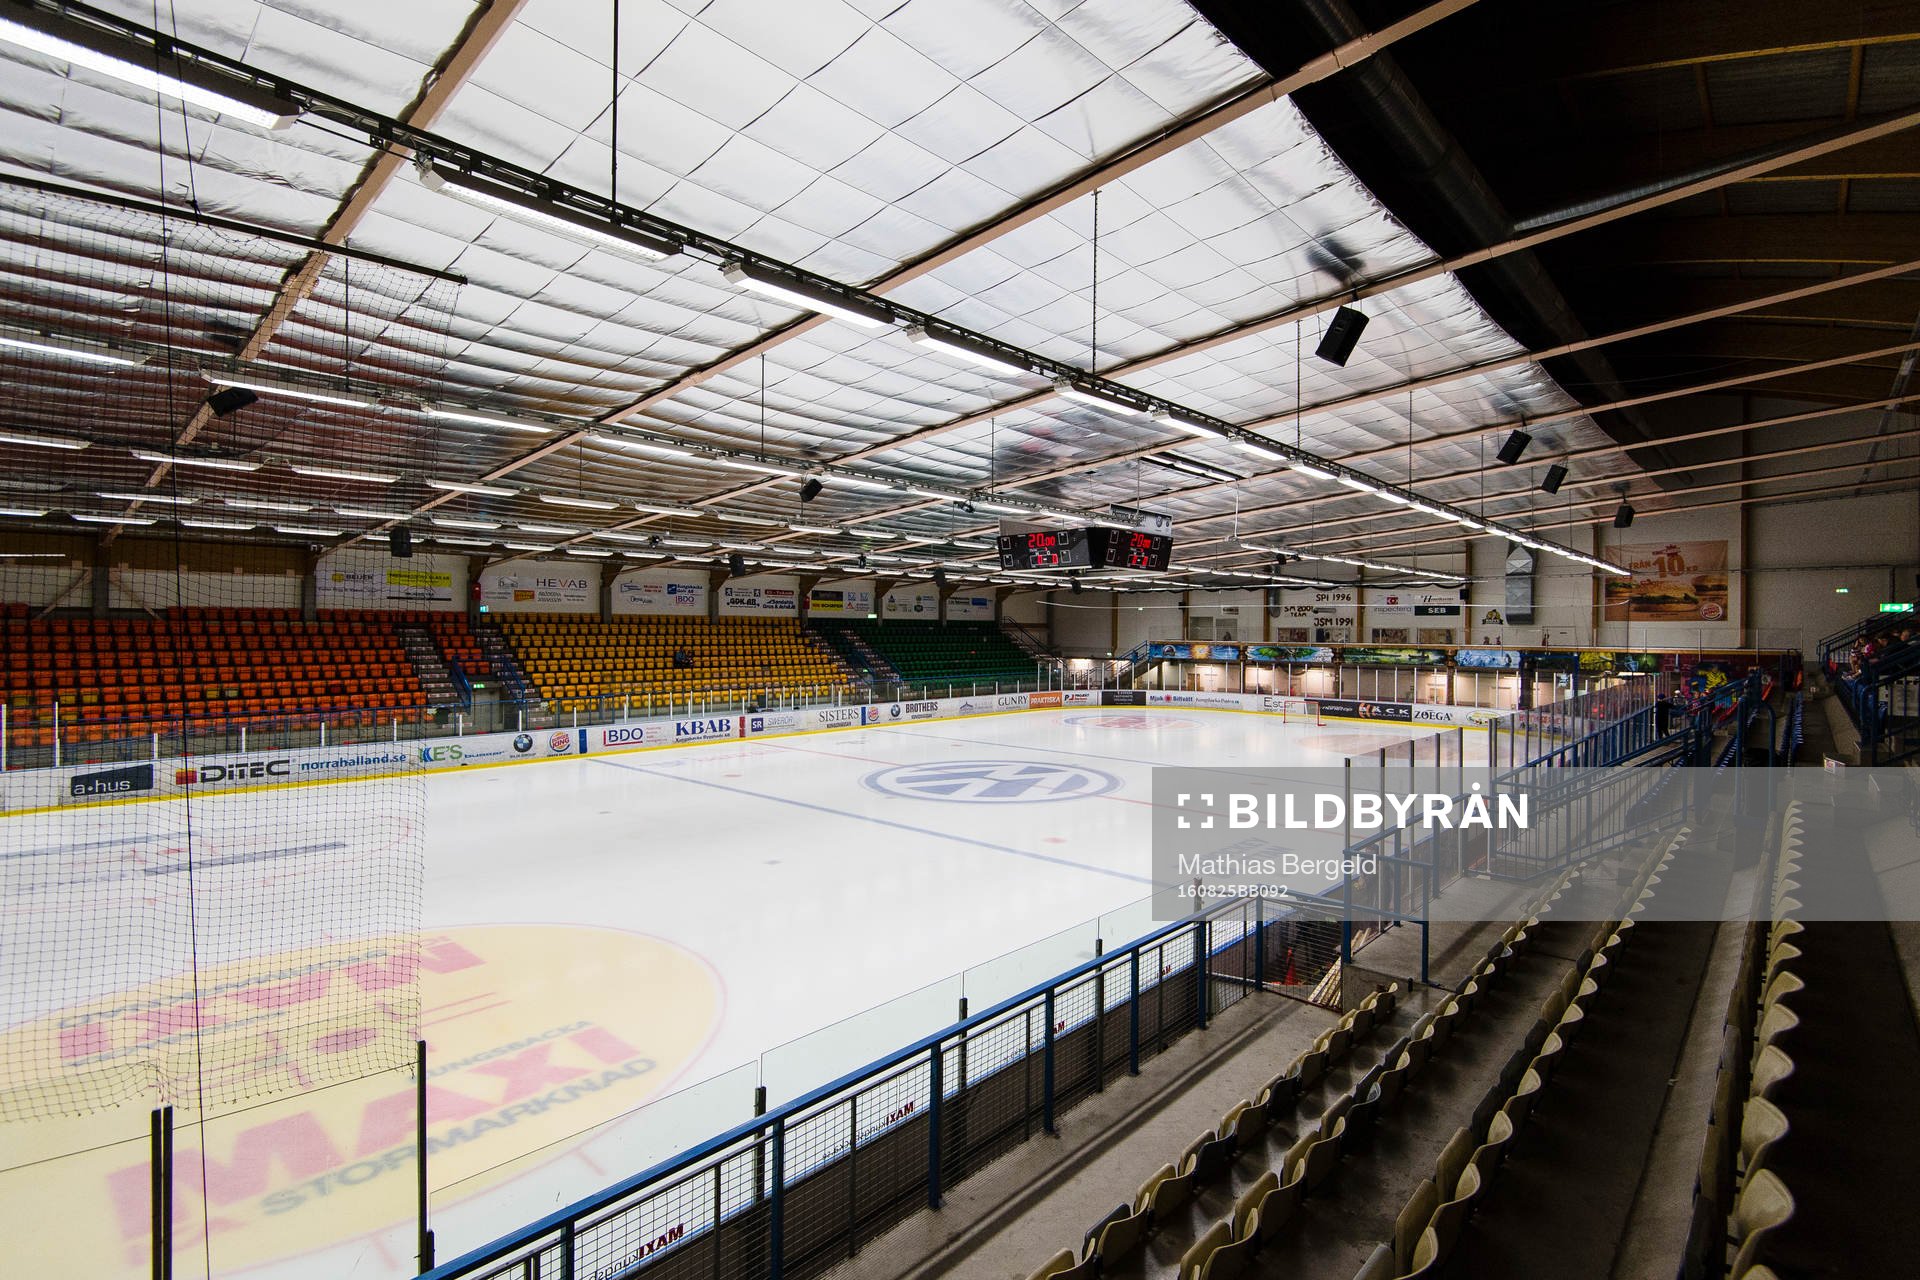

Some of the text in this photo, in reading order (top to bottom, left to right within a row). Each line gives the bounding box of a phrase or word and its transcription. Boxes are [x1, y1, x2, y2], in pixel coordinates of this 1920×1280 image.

[536, 578, 588, 589] HEVAB
[818, 708, 859, 723] SISTERS
[905, 701, 939, 714] BROTHERS
[675, 718, 731, 737] KBAB
[752, 720, 763, 729] SR
[608, 727, 644, 743] BDO
[300, 753, 407, 771] norrahalland.se
[105, 1024, 644, 1242] MAXI
[258, 1058, 660, 1218] STORMARKNAD
